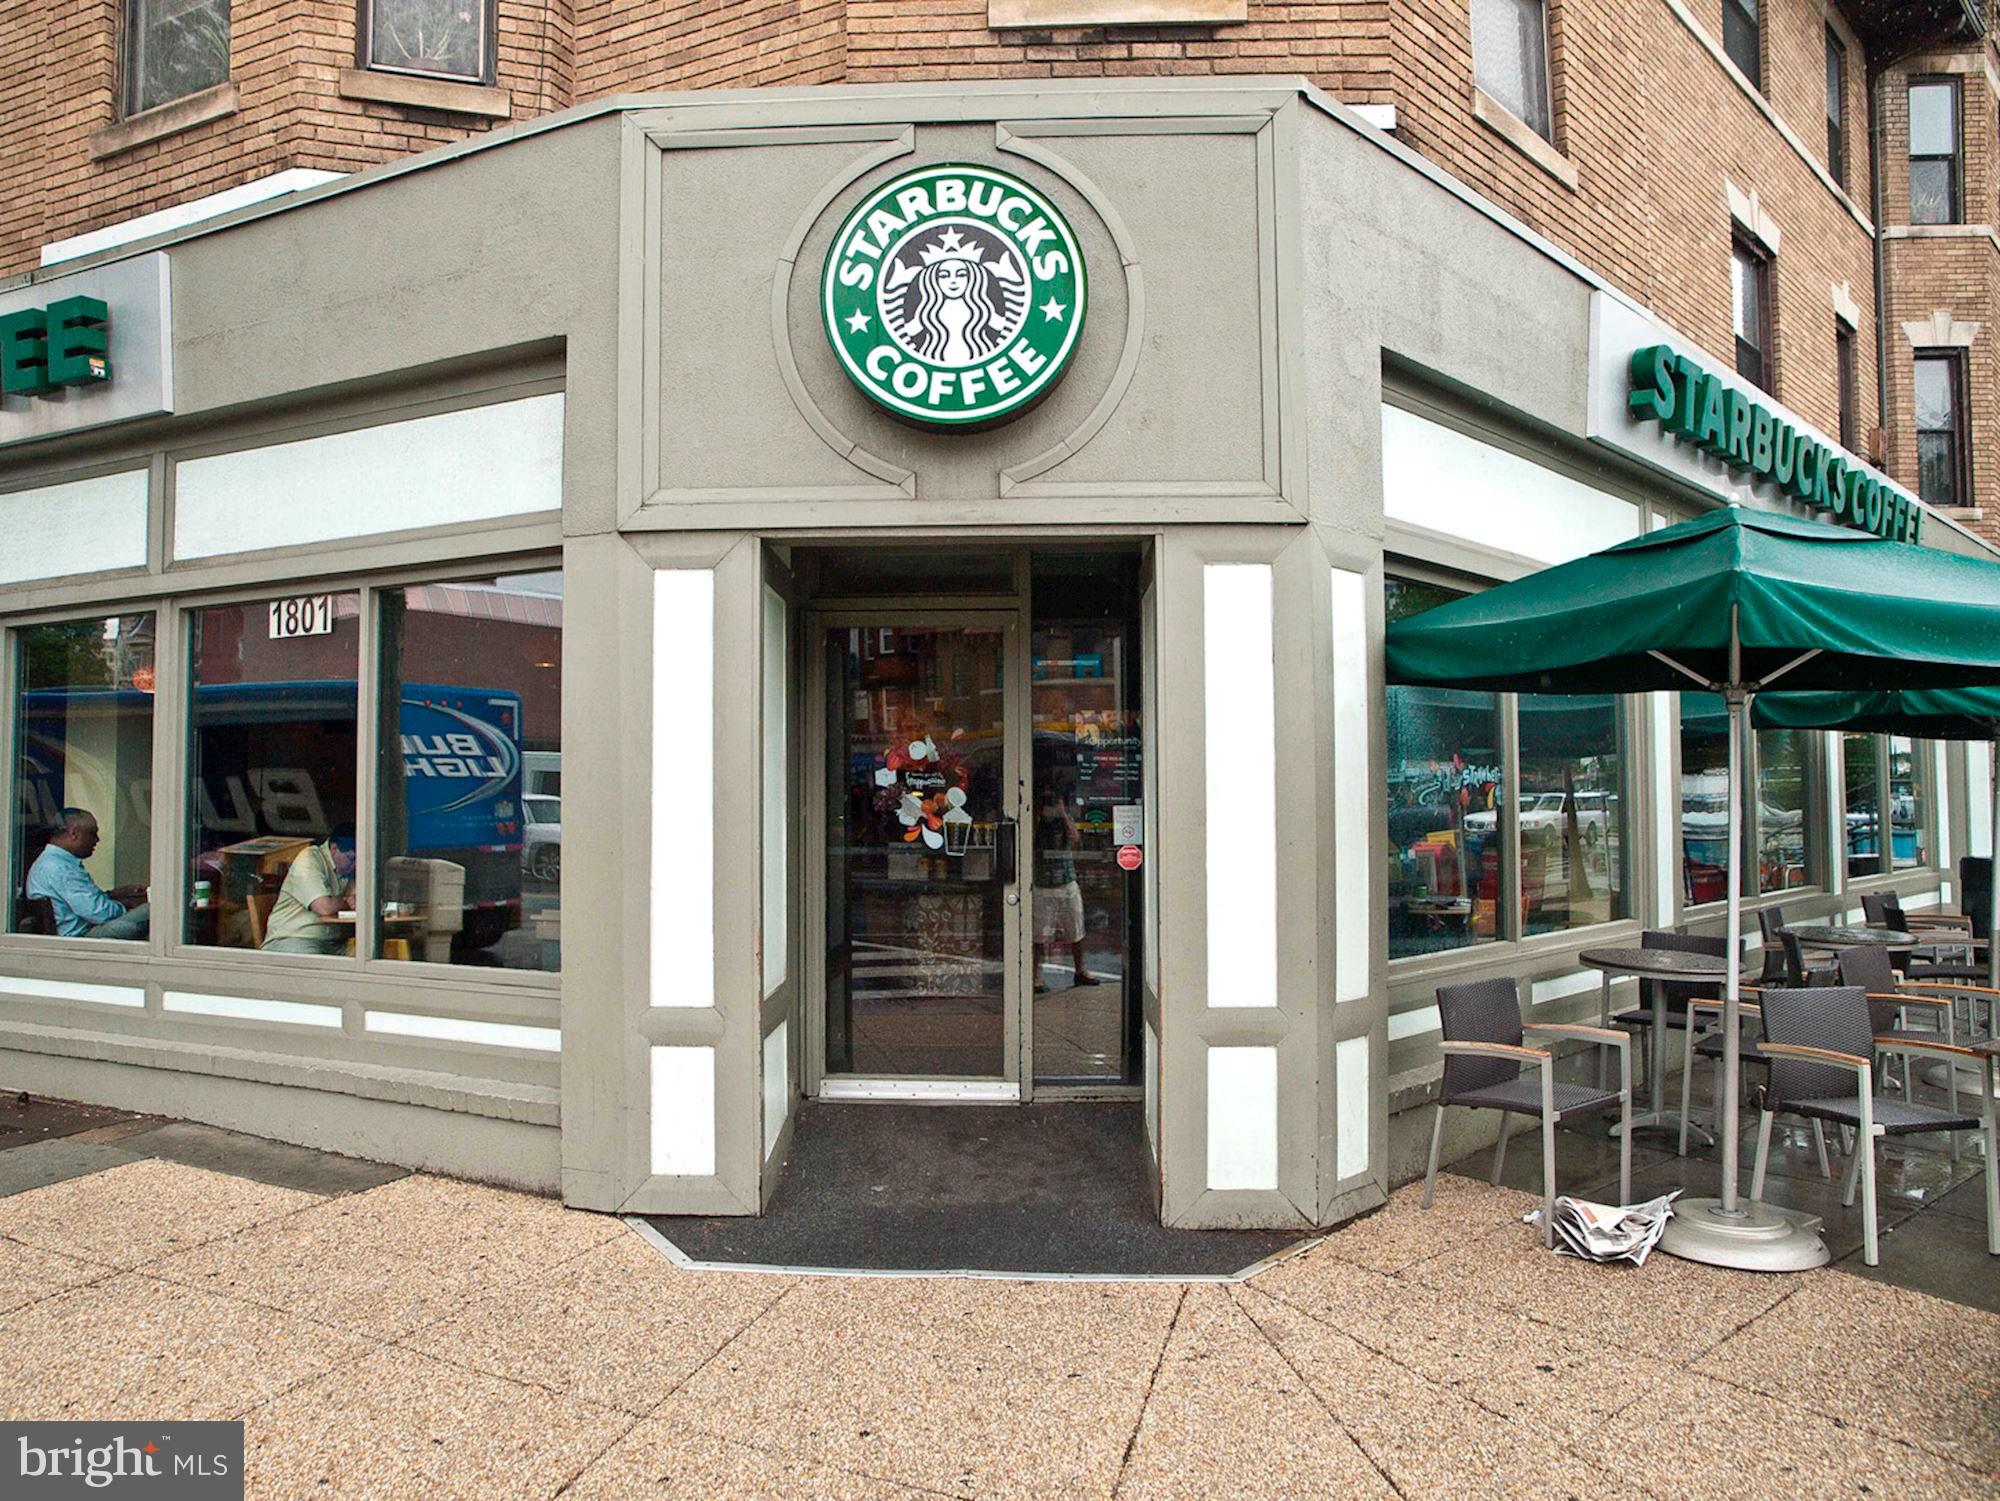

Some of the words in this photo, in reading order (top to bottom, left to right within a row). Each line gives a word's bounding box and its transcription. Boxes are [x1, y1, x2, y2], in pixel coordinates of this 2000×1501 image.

[839, 179, 1069, 291] STARBUCKS
[866, 337, 1047, 406] COFFEE
[1630, 344, 1848, 515] STARBUCKS
[273, 596, 328, 636] 1801
